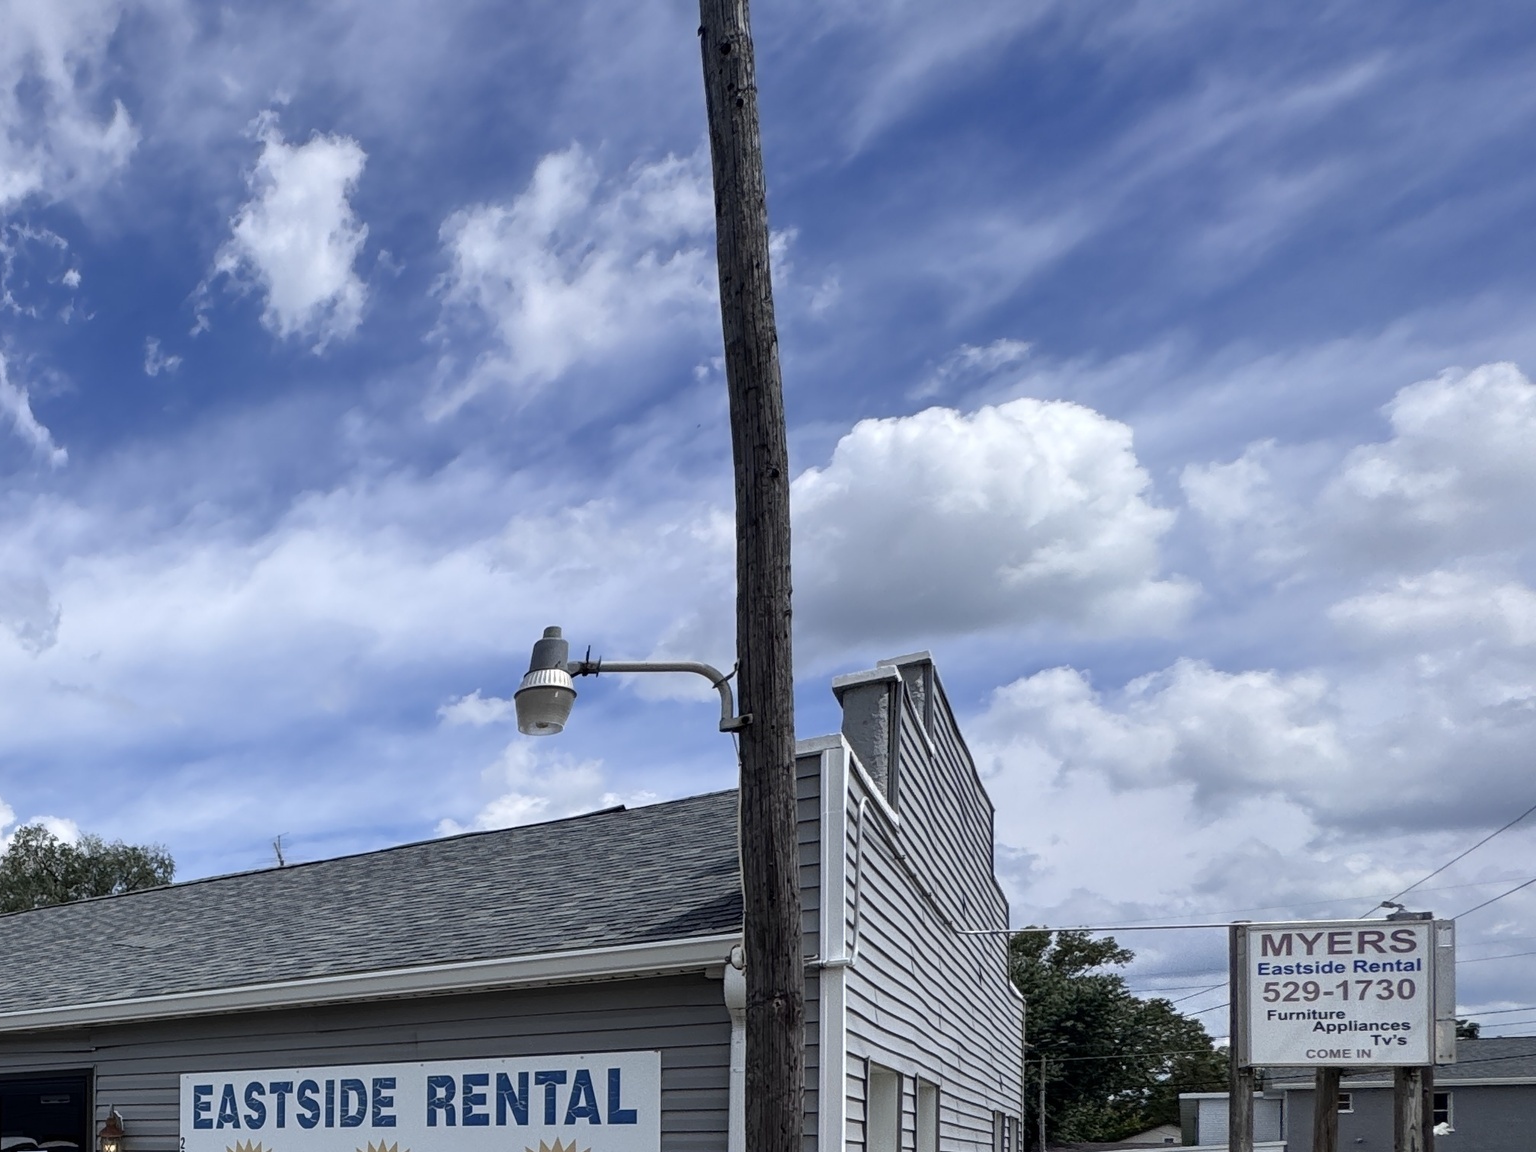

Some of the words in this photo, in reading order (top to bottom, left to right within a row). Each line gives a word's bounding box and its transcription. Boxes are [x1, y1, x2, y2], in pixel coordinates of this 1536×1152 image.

[1261, 929, 1417, 957] MYERS
[1258, 960, 1346, 975] Eastside
[1353, 958, 1421, 973] Rental
[1262, 978, 1416, 1002] 529-1730
[1267, 1009, 1346, 1020] Furniture
[1312, 1020, 1411, 1034] Appliances
[1370, 1034, 1407, 1046] Tv's
[1306, 1049, 1352, 1059] COME
[1356, 1049, 1371, 1059] IN
[193, 1077, 397, 1130] EASTSIDE
[426, 1068, 638, 1127] RENTAL
